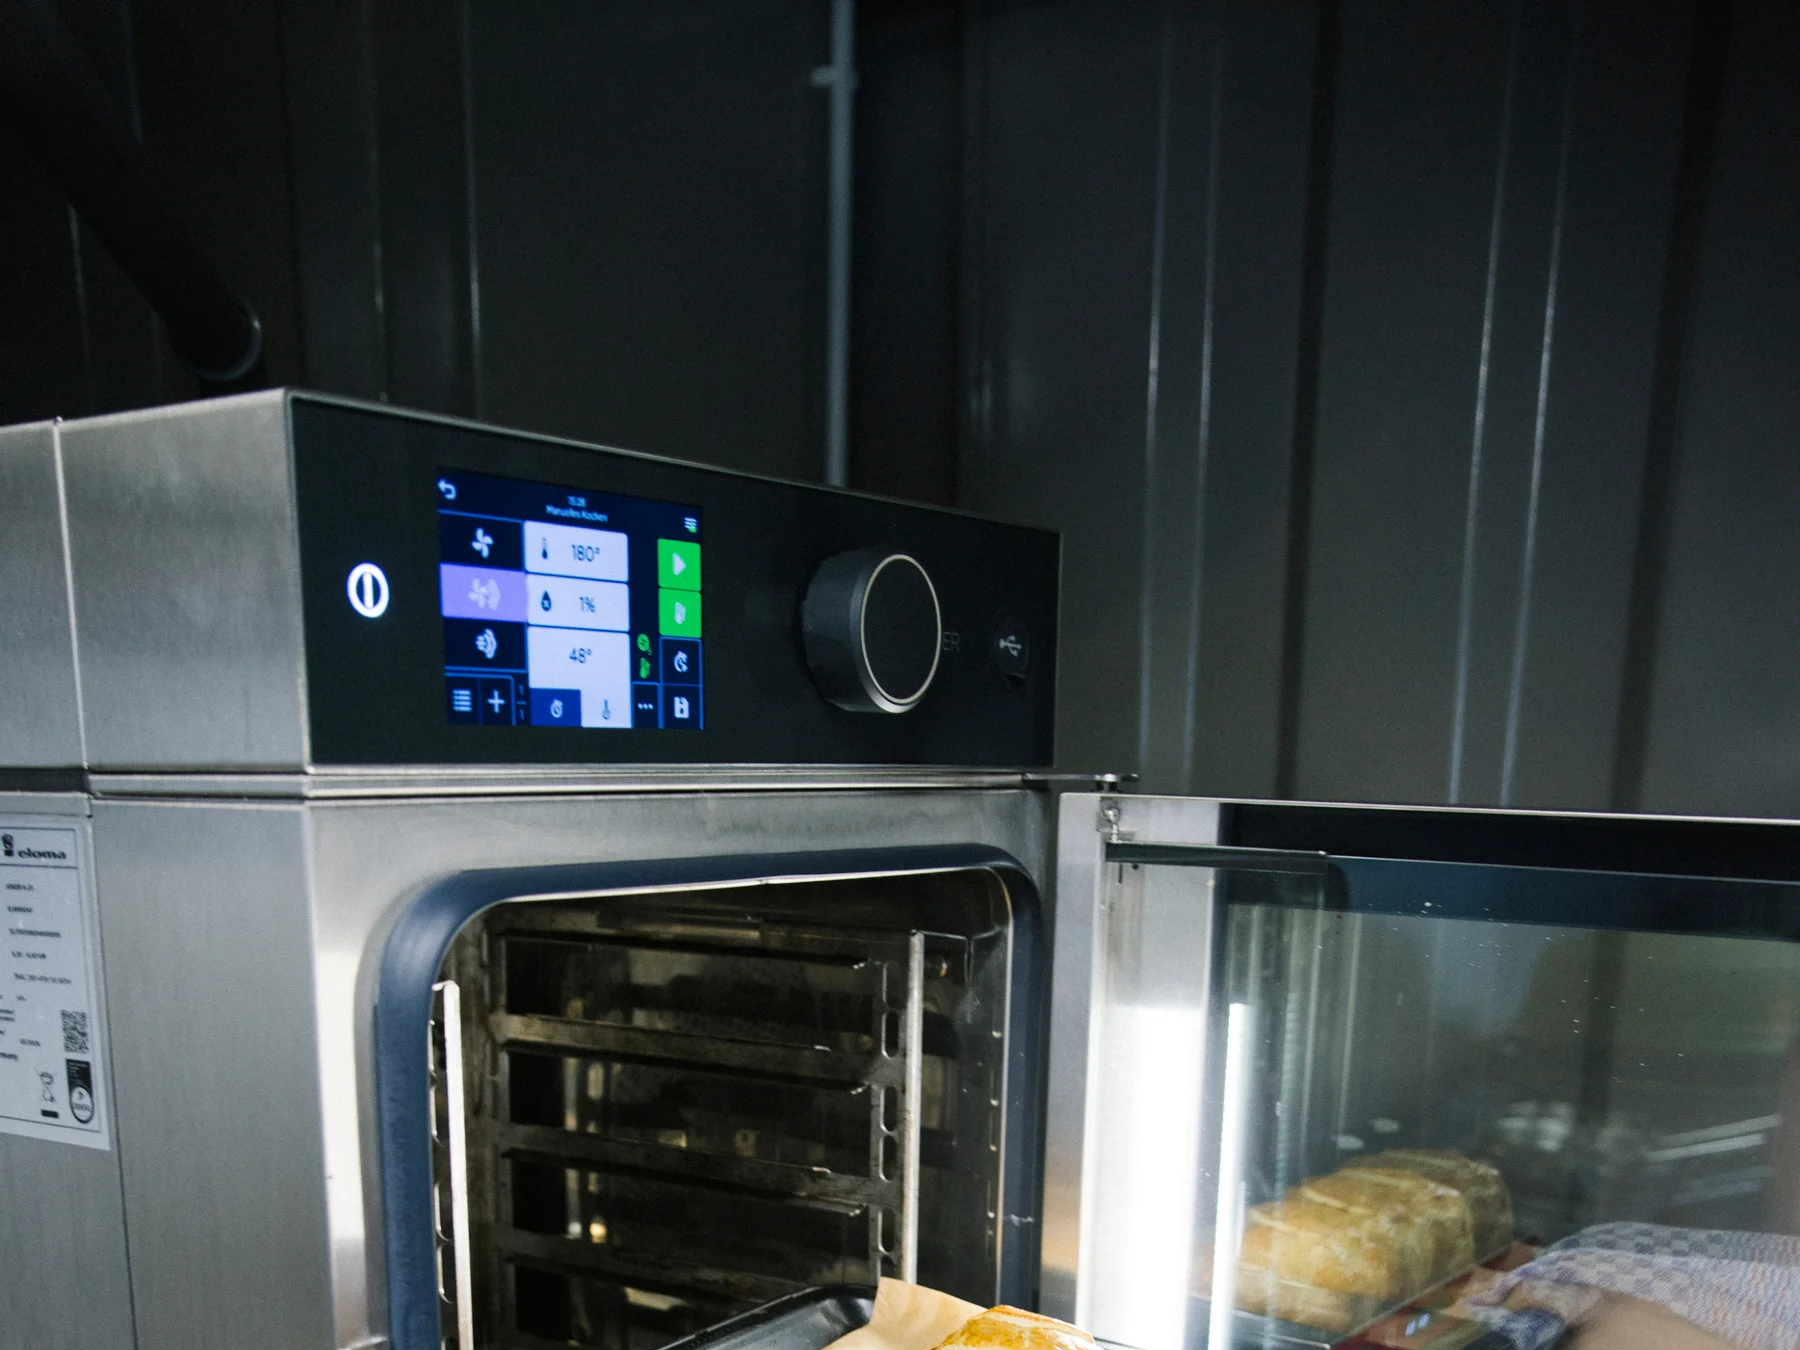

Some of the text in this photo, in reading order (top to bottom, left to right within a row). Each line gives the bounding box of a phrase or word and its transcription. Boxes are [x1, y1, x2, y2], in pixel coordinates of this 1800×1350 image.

[571, 543, 601, 562] 180°
[579, 596, 596, 614] 1%
[569, 647, 592, 665] 48°
[18, 847, 67, 860] eloma
